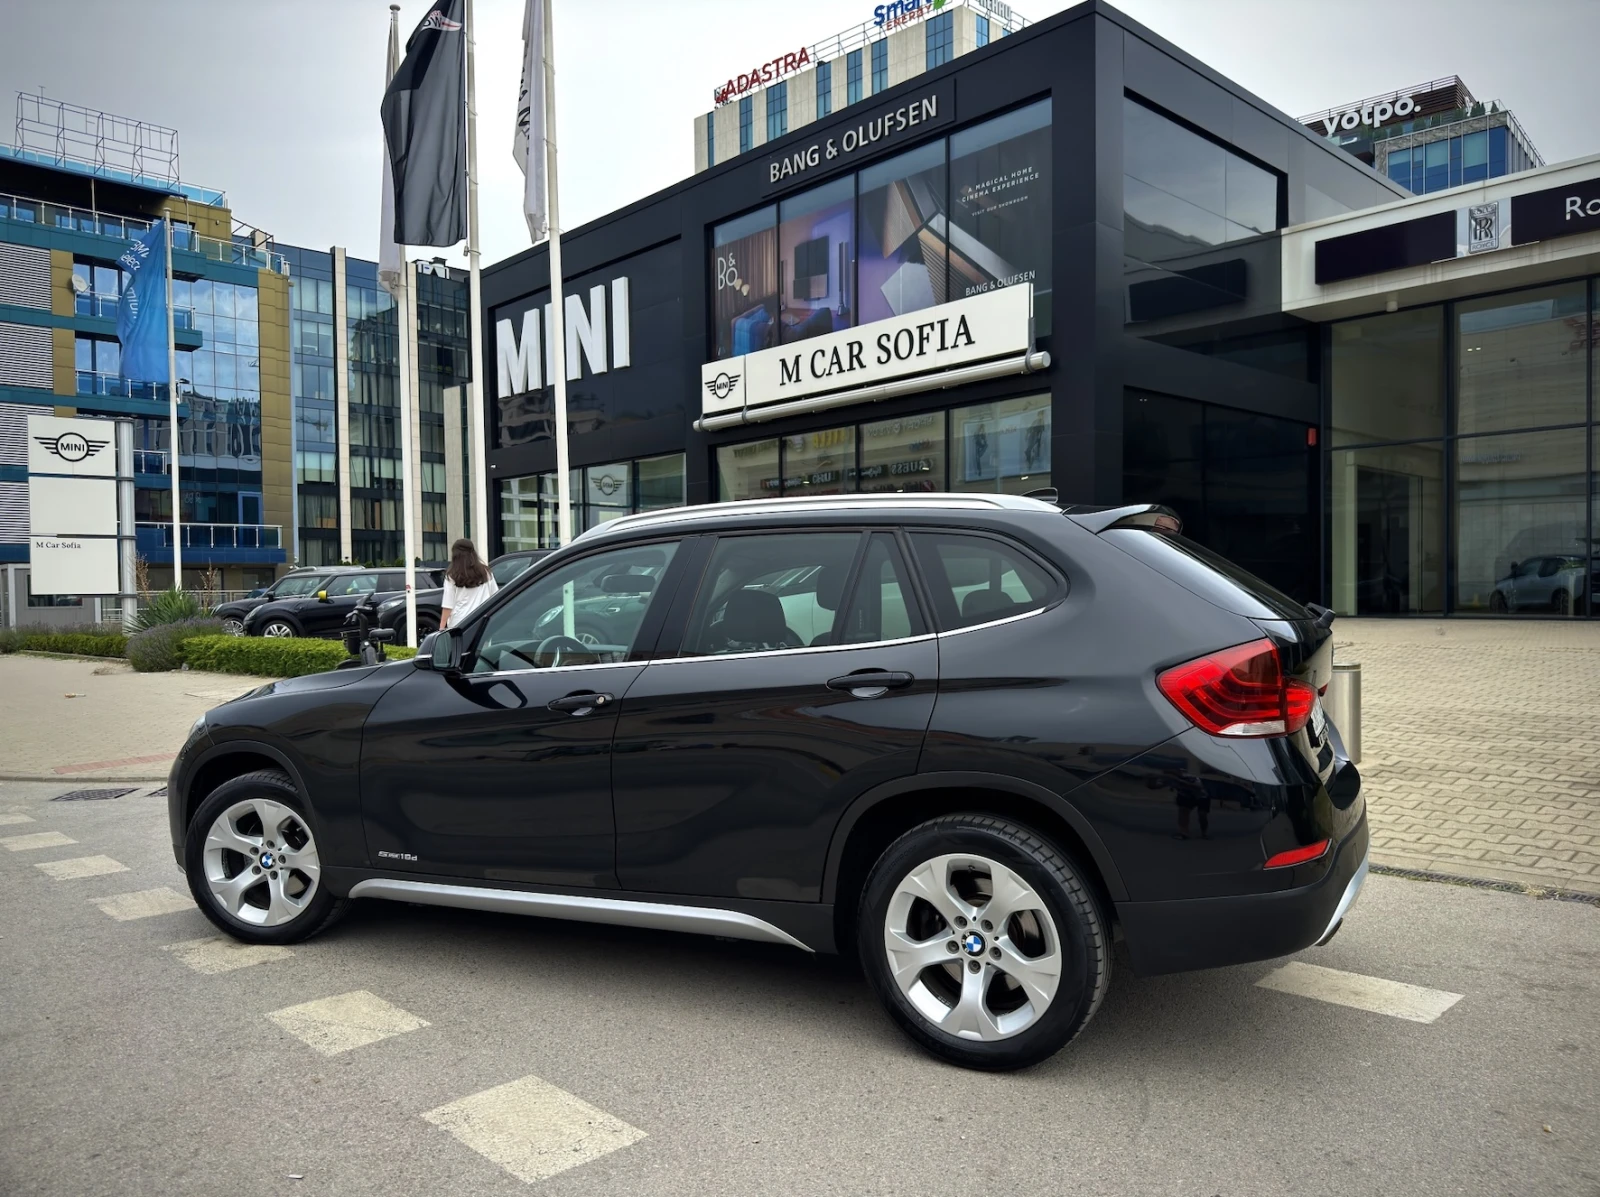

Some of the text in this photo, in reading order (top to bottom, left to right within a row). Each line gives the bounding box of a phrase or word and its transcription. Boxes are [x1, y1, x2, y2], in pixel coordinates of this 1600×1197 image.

[874, 0, 932, 26] Sma
[725, 46, 811, 100] ADASTRA
[769, 95, 937, 183] BANG & OLUFSEN
[961, 172, 1039, 203] CINEMA EXPERIENCE
[975, 175, 1008, 191] MAGICAL
[1011, 166, 1033, 178] HOME
[965, 270, 1036, 297] BANG & OLUFSEN
[496, 276, 631, 399] MINI
[779, 314, 976, 386] M CAR SOFIA
[60, 443, 85, 452] MINI
[61, 541, 81, 549] Sofia
